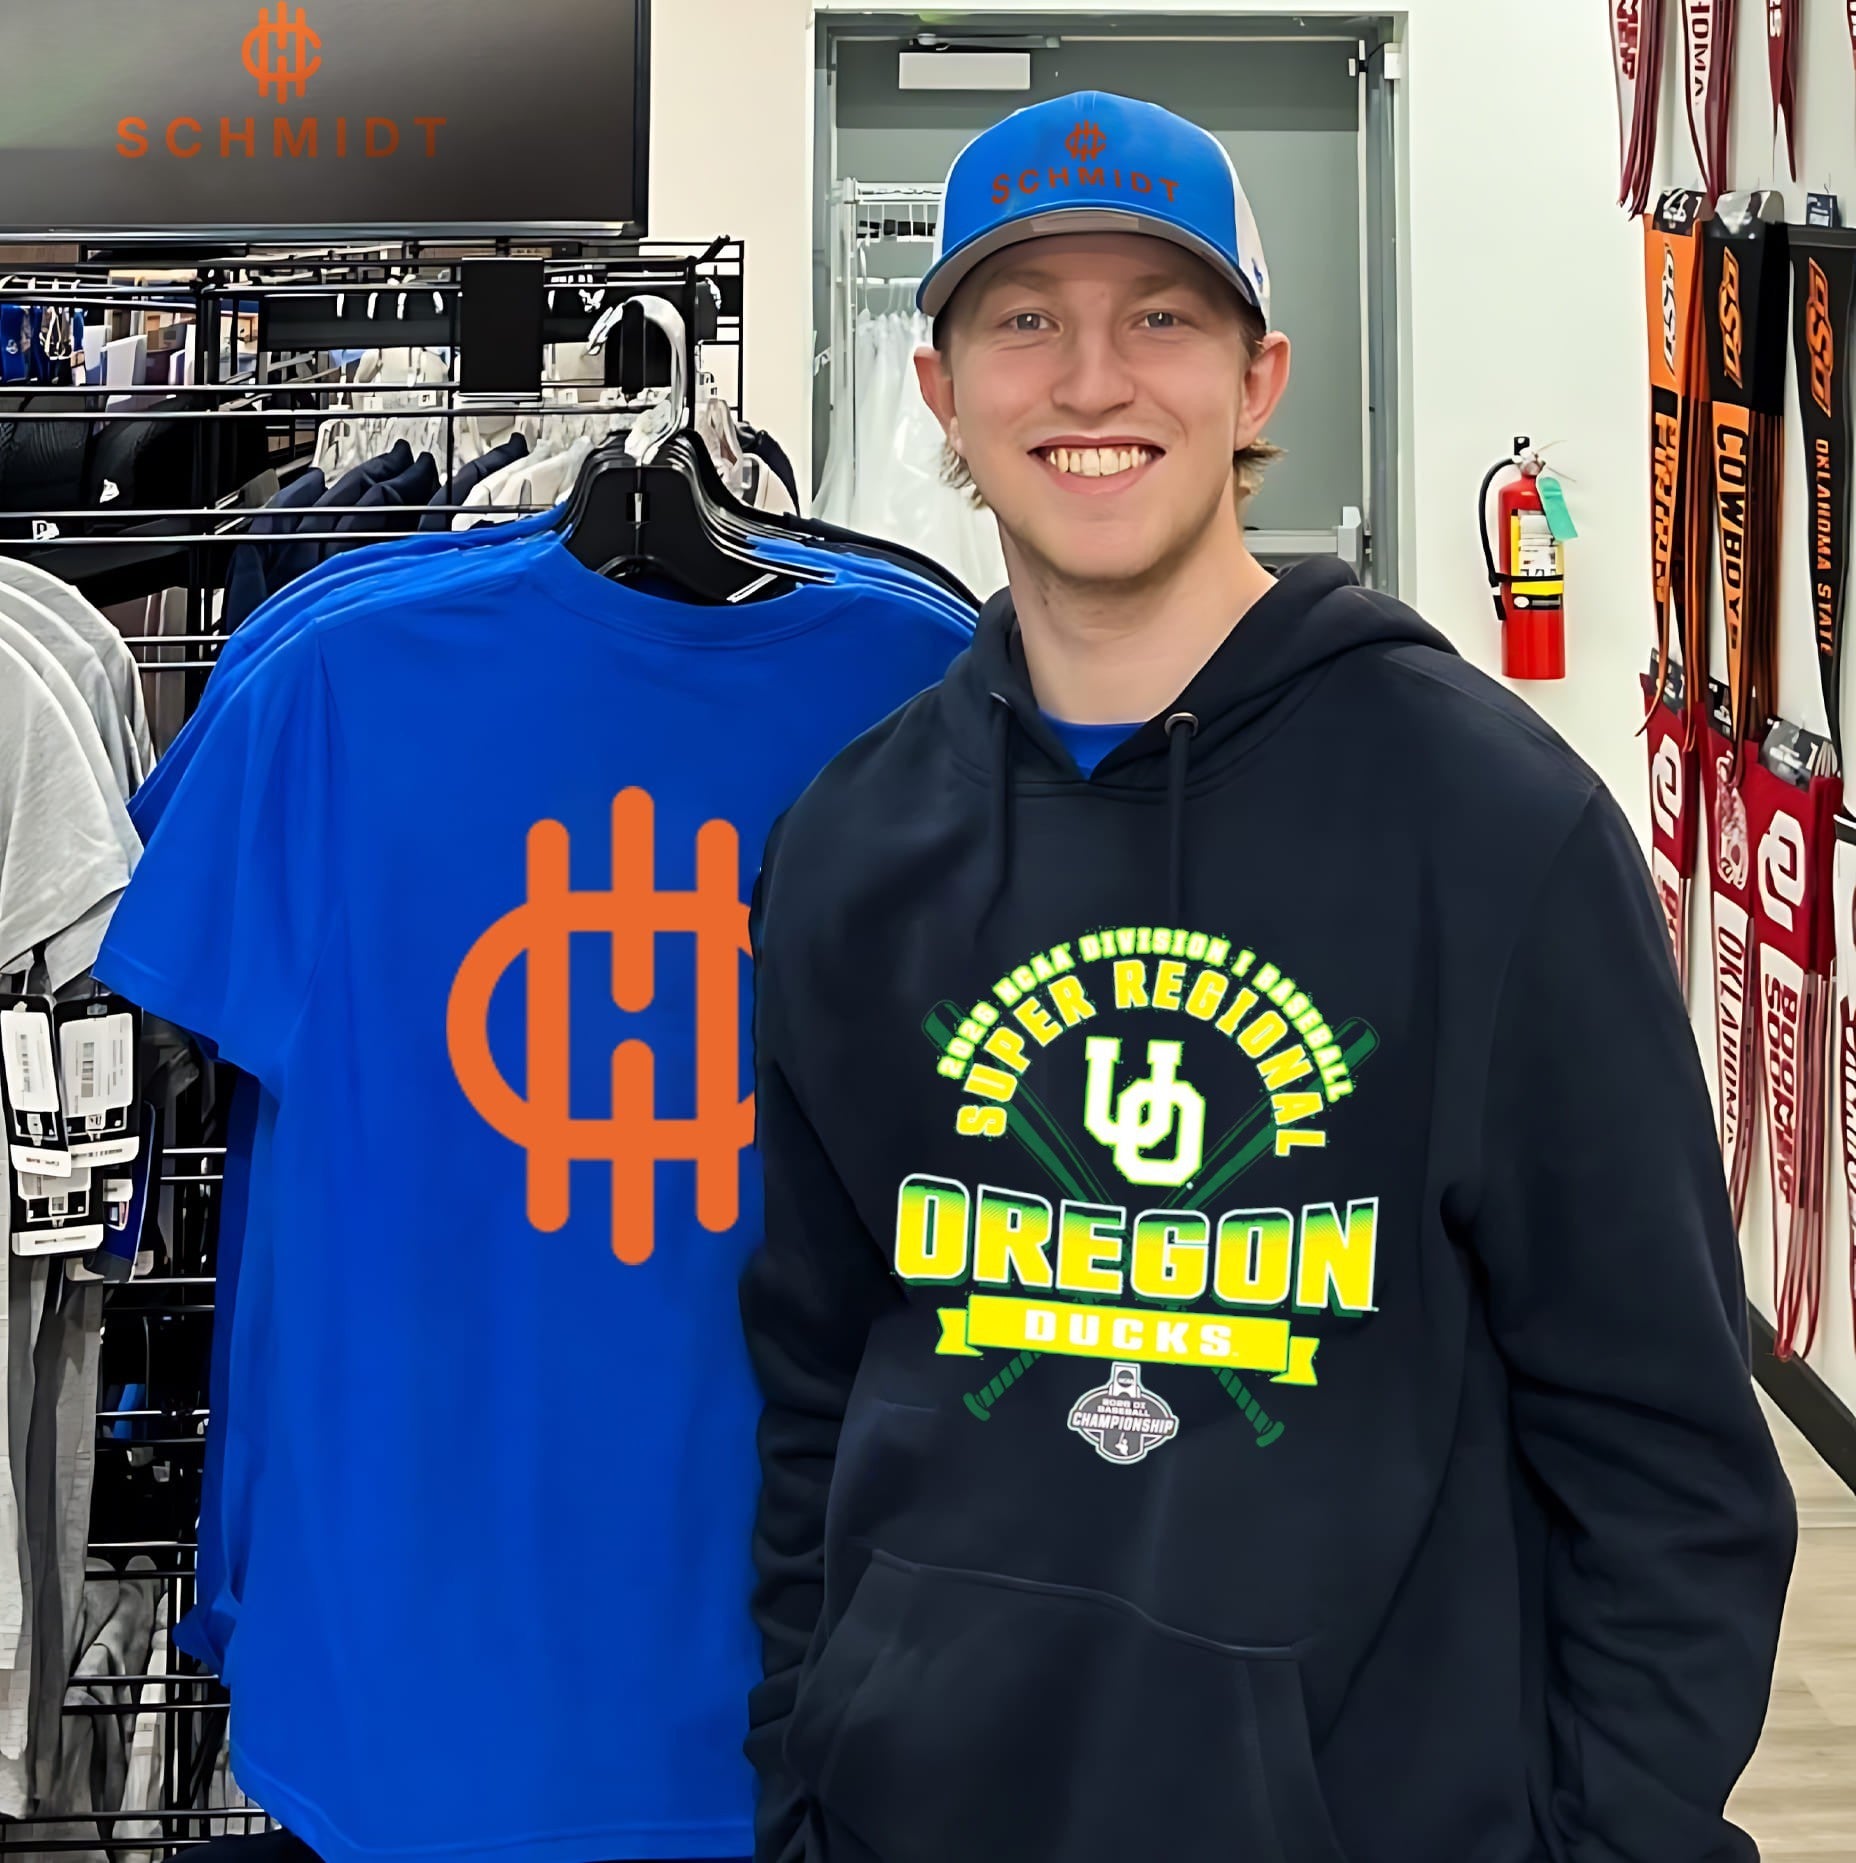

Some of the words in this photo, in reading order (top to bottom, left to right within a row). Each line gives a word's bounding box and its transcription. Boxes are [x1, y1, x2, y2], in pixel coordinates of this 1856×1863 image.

[115, 116, 448, 159] SCHMIDT
[991, 166, 1179, 205] SCHMIDT
[1815, 438, 1833, 570] OKLAHOMA
[937, 1001, 1000, 1080] 2026
[992, 942, 1076, 1008] NCAA
[1078, 927, 1231, 967] DIVISION
[1231, 949, 1256, 977] I
[1252, 962, 1354, 1103] BASEBALL
[956, 974, 1097, 1137] SUPER
[1113, 959, 1326, 1157] REGIONAL
[895, 1172, 1380, 1316] OREGON
[1025, 1309, 1232, 1356] DUCKS
[1071, 1411, 1174, 1434] CHAMPIONSHIP
[1097, 1405, 1150, 1417] BASEBALL
